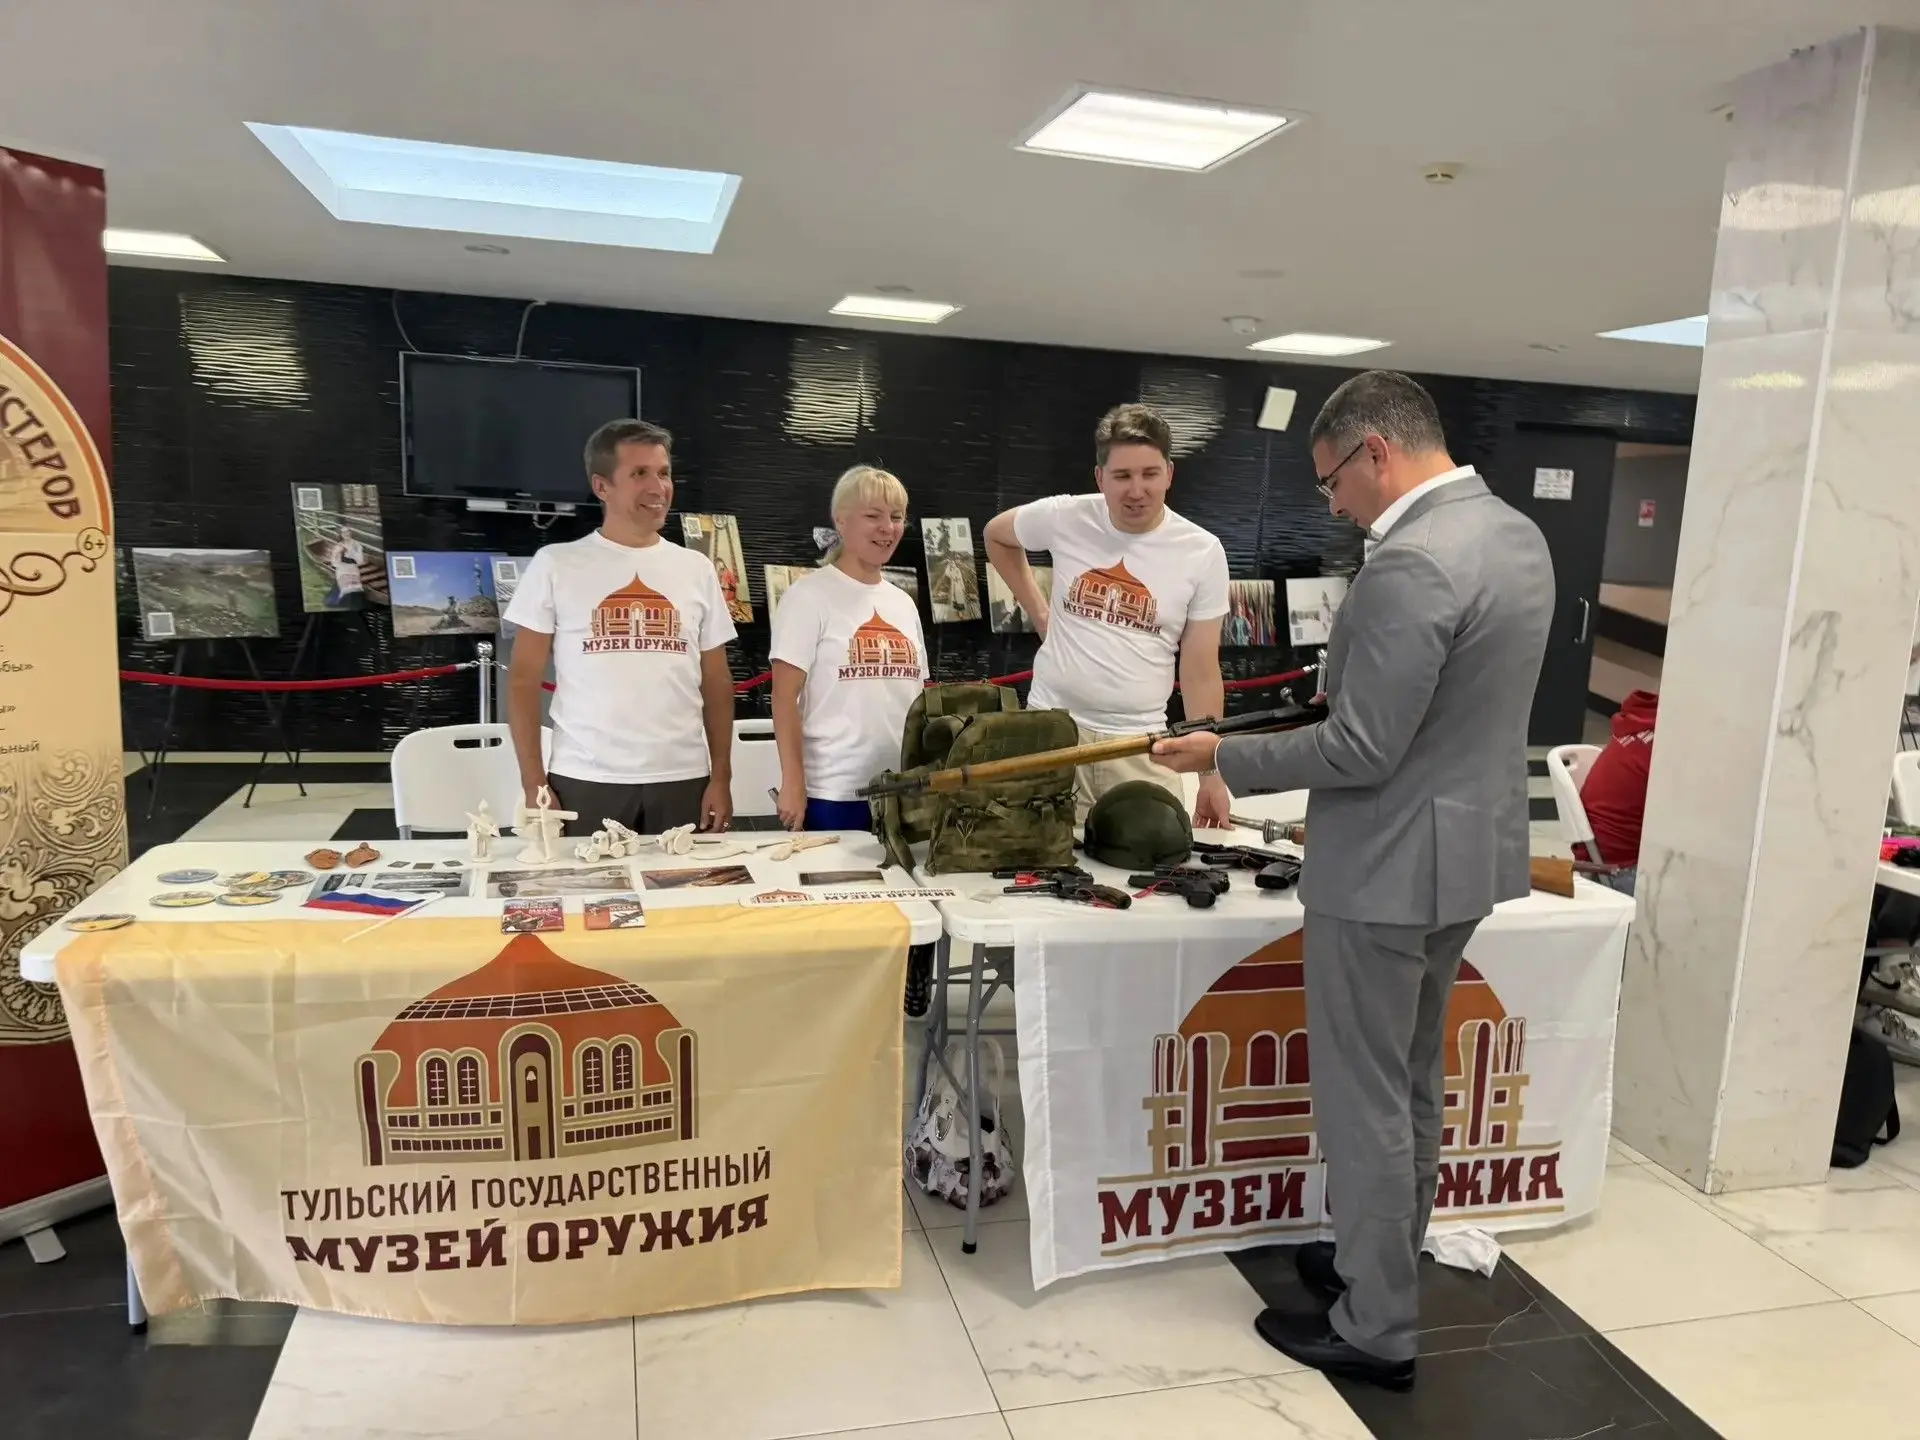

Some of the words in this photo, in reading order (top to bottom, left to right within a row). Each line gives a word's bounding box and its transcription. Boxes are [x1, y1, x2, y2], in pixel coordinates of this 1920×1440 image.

[83, 534, 104, 551] 6+
[635, 638, 689, 652] ОРУЖИЯ
[281, 1174, 456, 1221] ТУЛЬСКИЙ
[471, 1146, 771, 1210] ГОСУДАРСТВЕННЫЙ
[1098, 1167, 1306, 1244] МУЗЕЙ
[286, 1217, 507, 1274] МУЗЕЙ
[527, 1193, 769, 1263] ОРУЖИЯ
